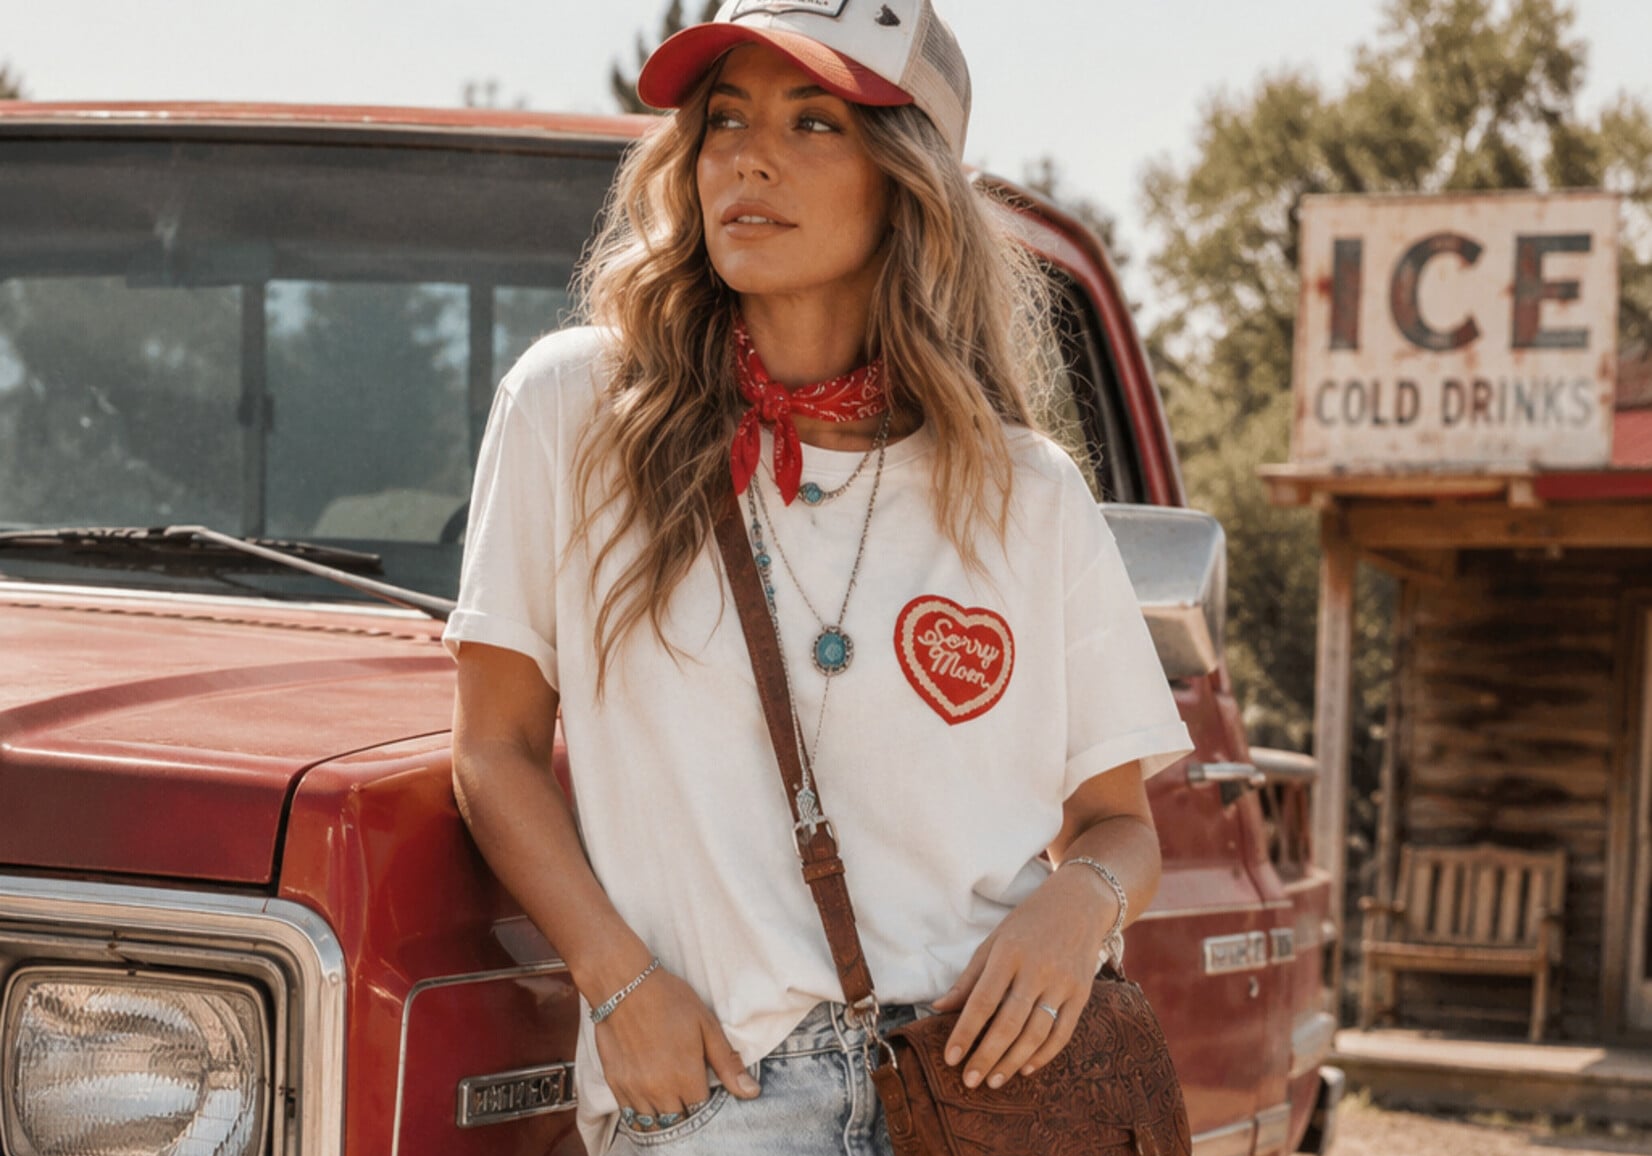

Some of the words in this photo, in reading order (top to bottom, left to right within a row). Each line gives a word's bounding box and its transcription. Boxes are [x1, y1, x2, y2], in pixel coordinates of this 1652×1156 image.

[1329, 232, 1592, 351] ICE
[1315, 379, 1420, 427] COLD
[1440, 377, 1595, 426] DRINKS
[917, 618, 999, 669] Sorry
